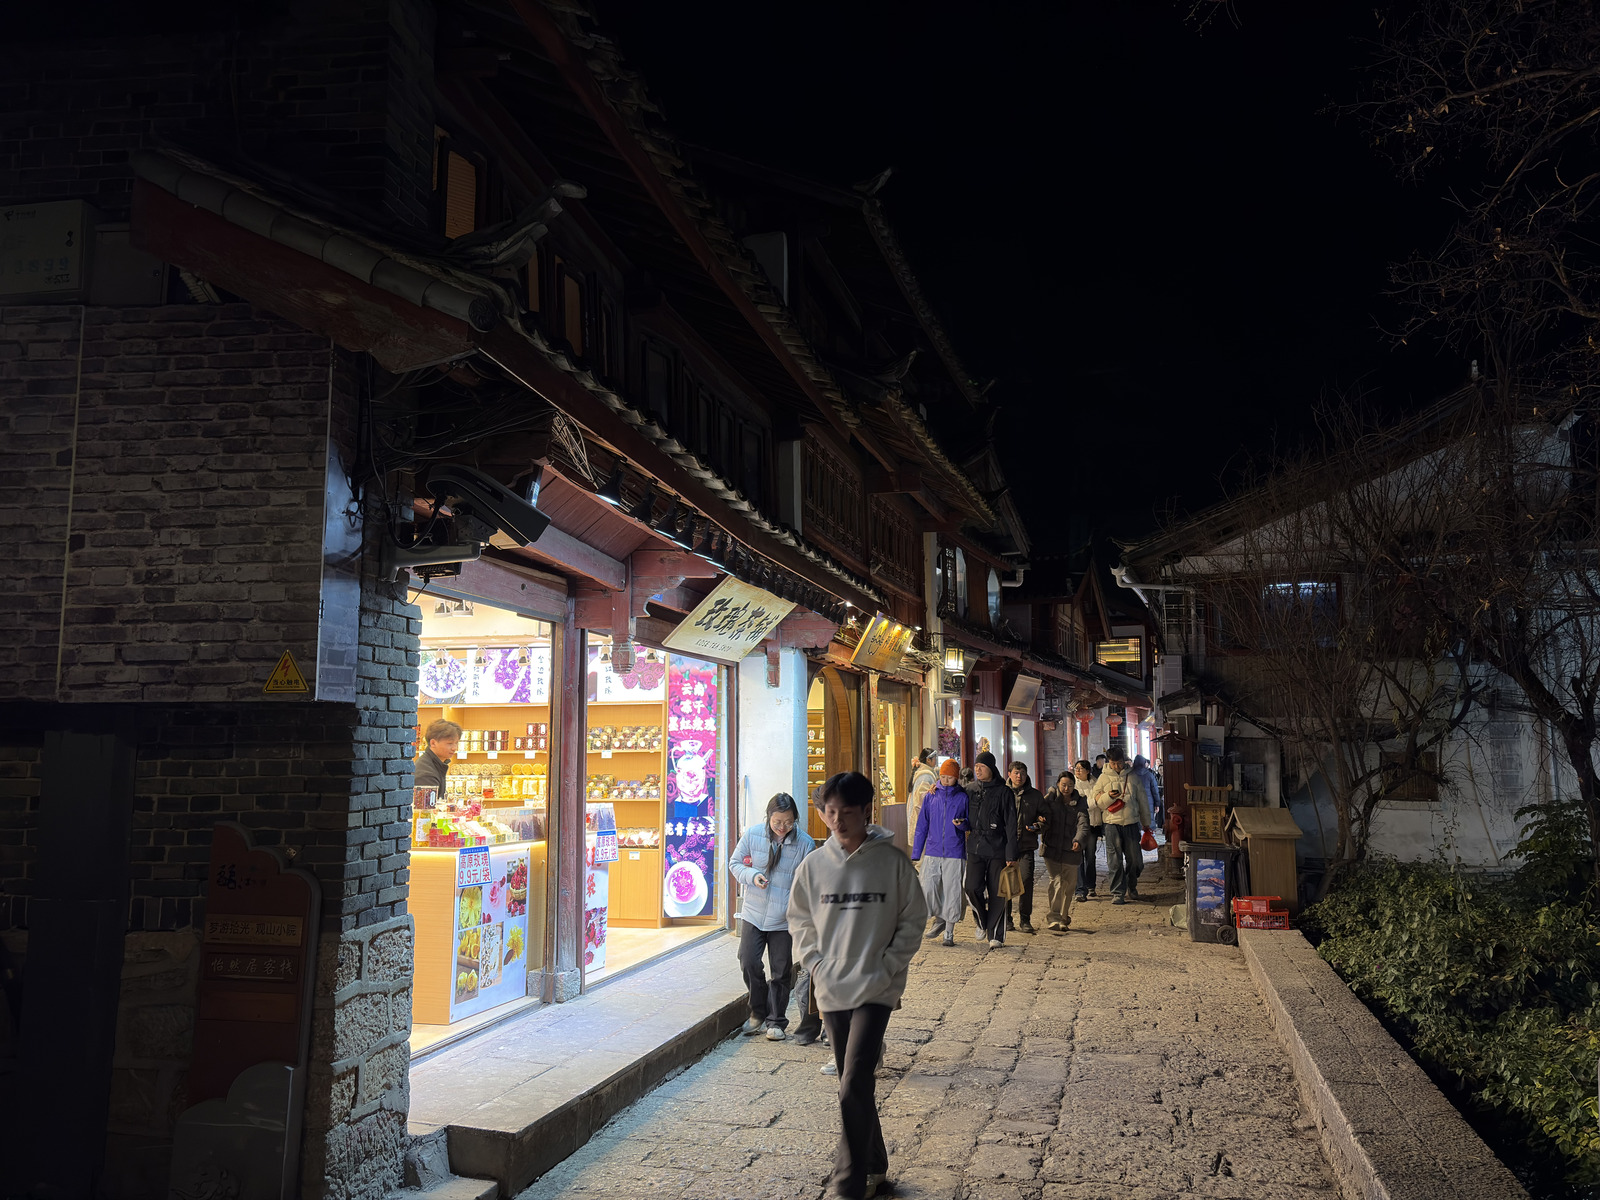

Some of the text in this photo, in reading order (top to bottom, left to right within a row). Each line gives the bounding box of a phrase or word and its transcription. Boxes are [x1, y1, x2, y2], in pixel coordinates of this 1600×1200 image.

[694, 597, 780, 643] 玫瑰茶铺
[695, 638, 711, 648] ROSE
[681, 681, 705, 697] 云南
[597, 835, 617, 847] 高原玫瑰
[460, 852, 489, 869] 高原玫瑰
[459, 867, 491, 885] 9.9元/袋
